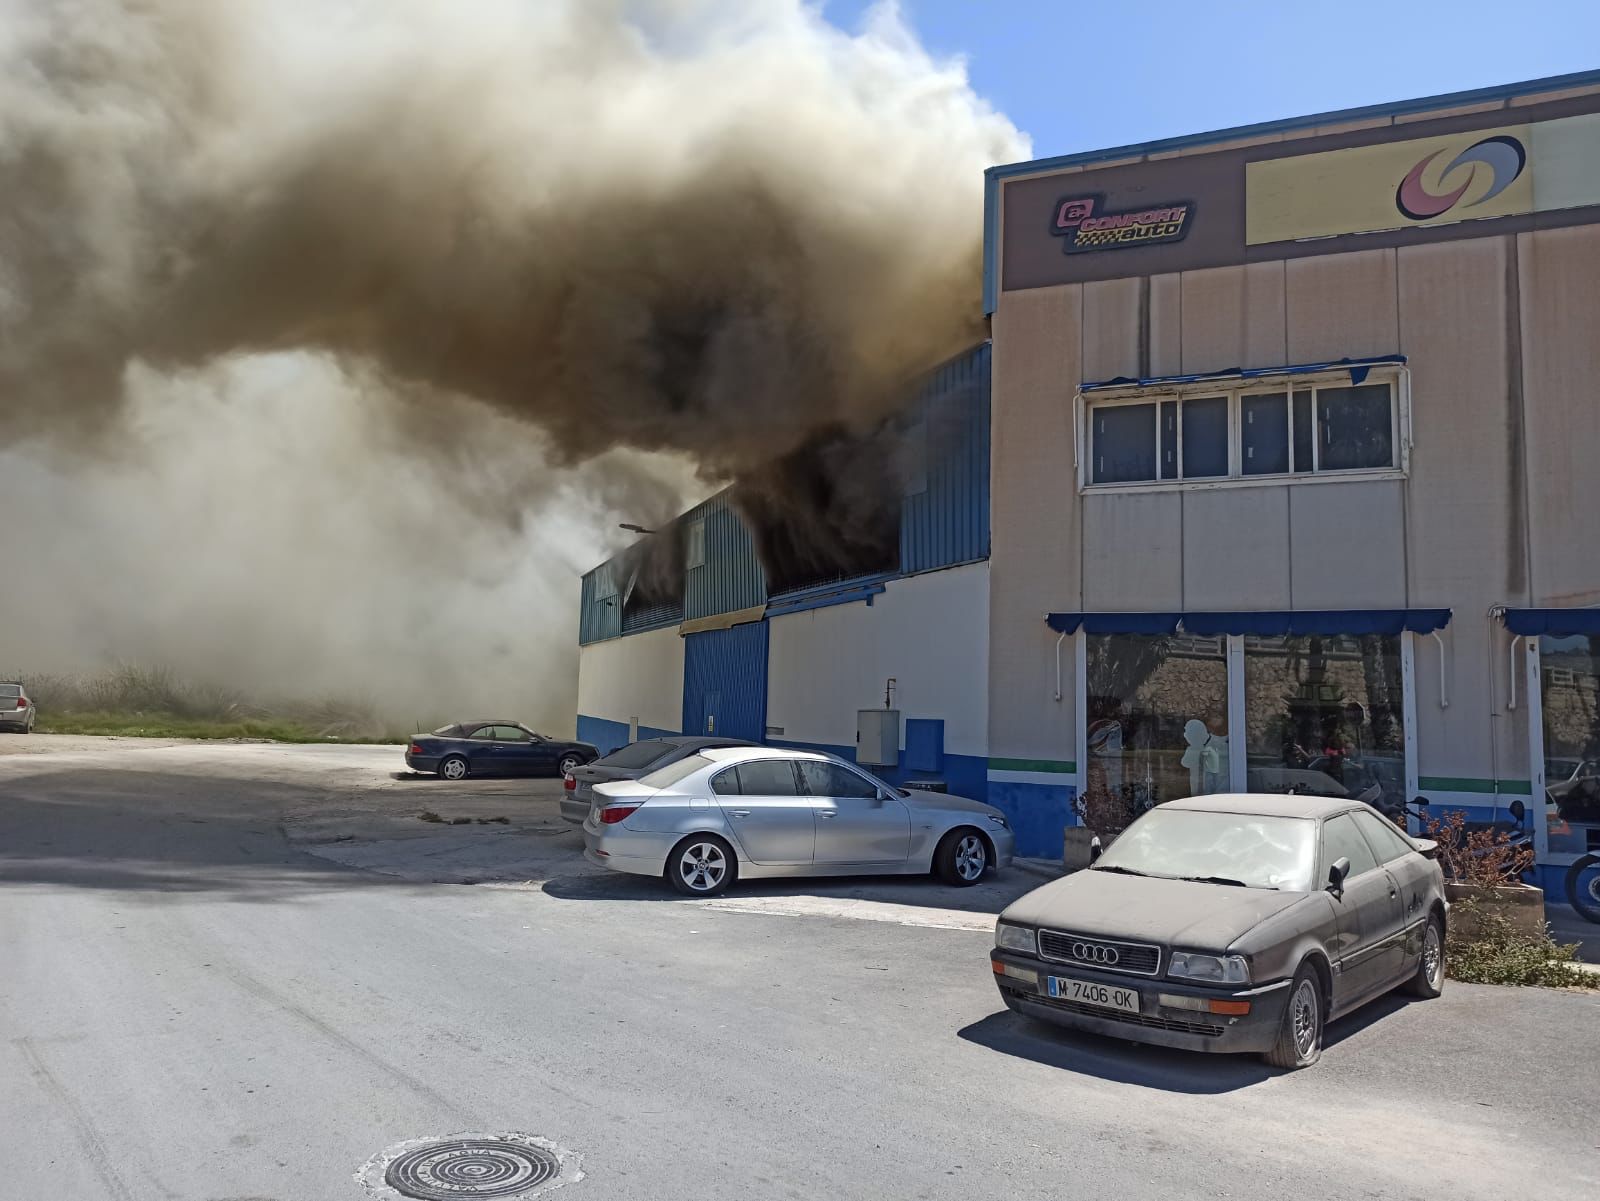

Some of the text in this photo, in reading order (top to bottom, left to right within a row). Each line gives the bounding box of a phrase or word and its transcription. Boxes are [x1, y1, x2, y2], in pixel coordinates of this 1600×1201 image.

[1080, 206, 1187, 231] CONFORT
[1121, 223, 1178, 239] auto
[1058, 980, 1133, 1009] M 7406 OK
